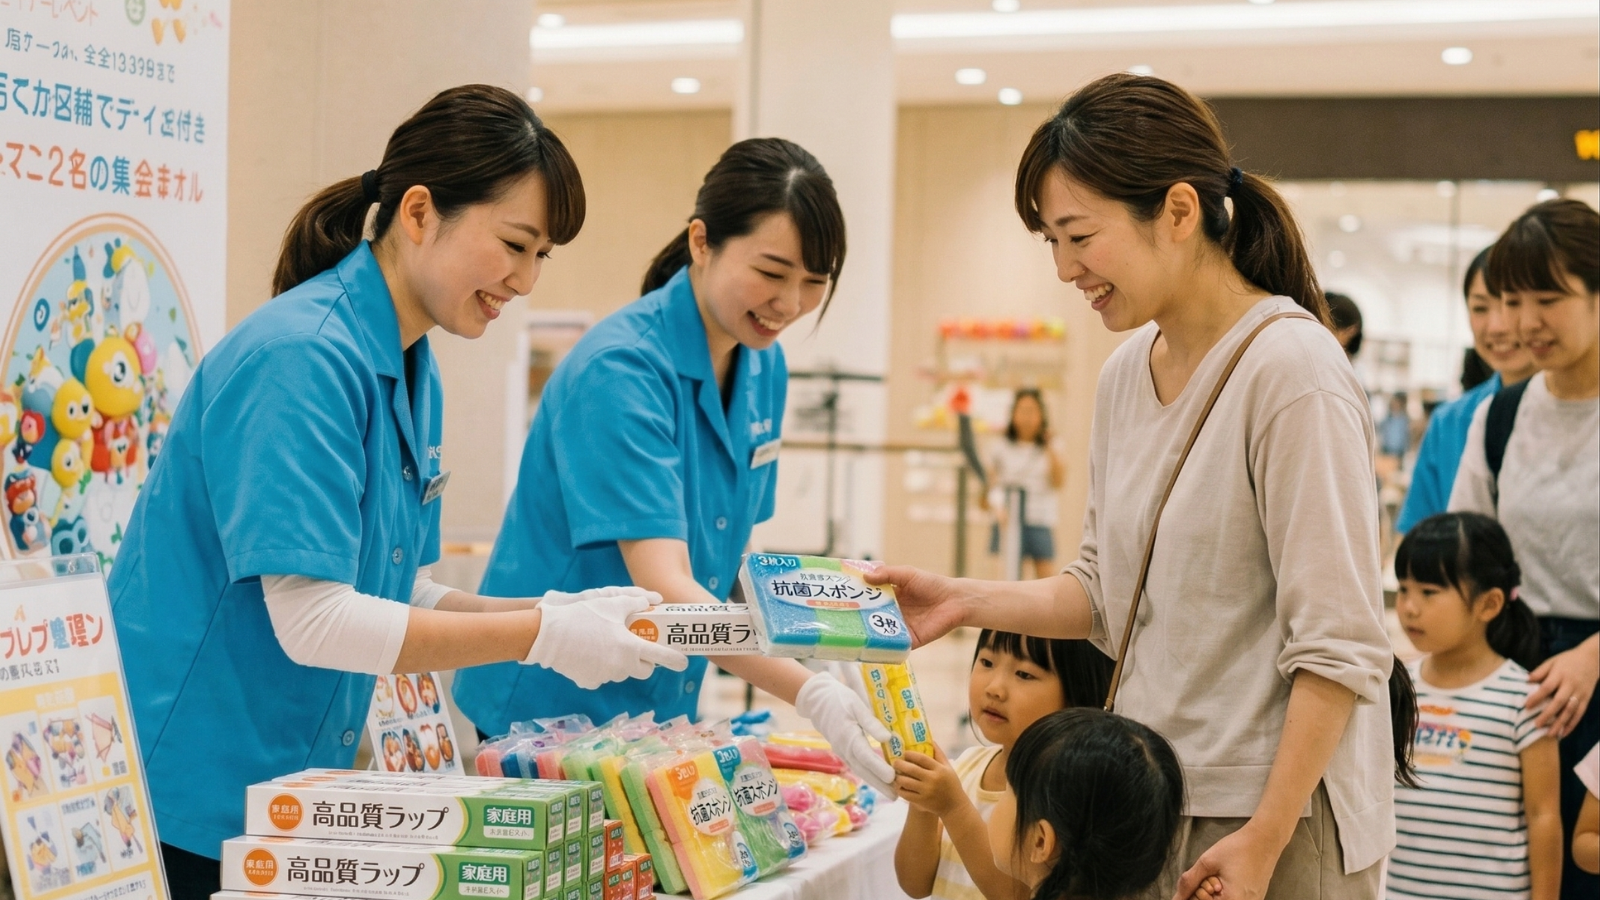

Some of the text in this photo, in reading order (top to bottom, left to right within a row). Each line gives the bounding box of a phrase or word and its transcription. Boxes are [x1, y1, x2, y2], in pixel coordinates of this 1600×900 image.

[771, 579, 882, 600] 抗菌スポンジ
[733, 778, 778, 807] 抗菌スポンジ
[312, 801, 449, 831] 高品質ラップ
[486, 807, 532, 826] 家庭用
[690, 795, 731, 826] 抗菌スポンジ
[287, 856, 425, 887] 高品質ラップ
[462, 865, 507, 882] 家庭用
